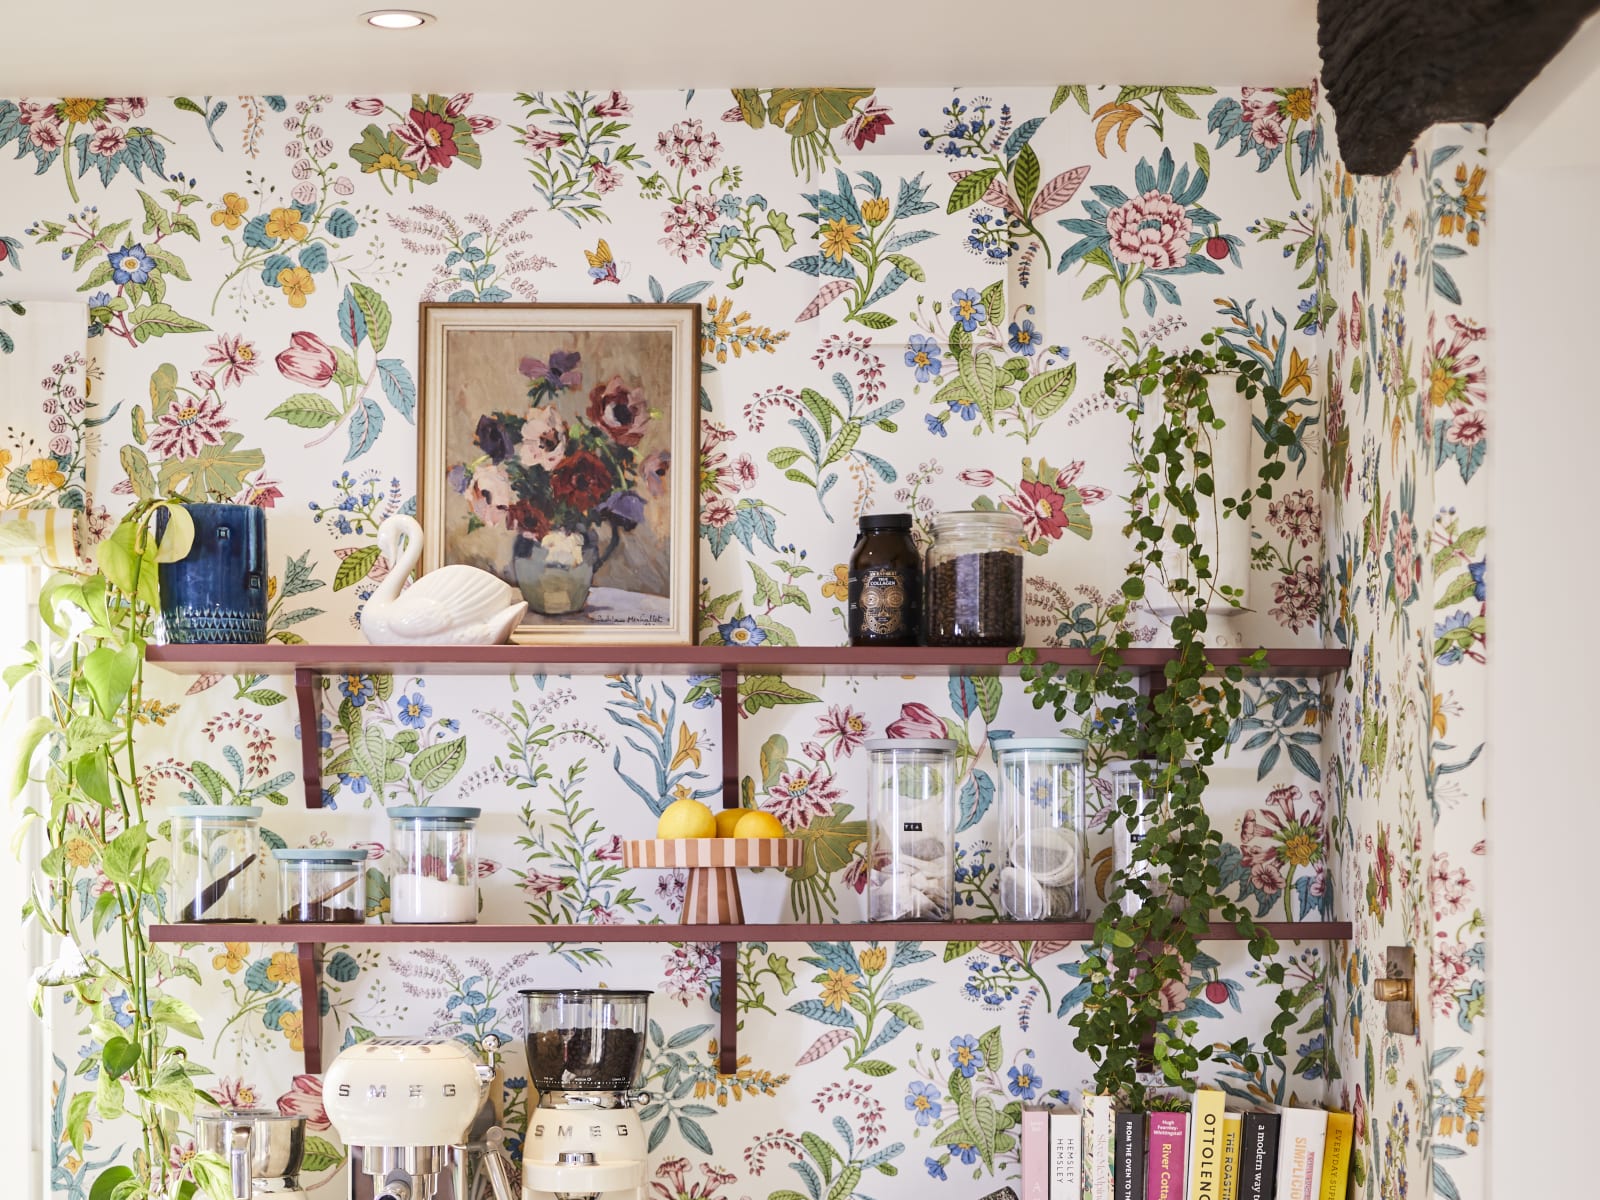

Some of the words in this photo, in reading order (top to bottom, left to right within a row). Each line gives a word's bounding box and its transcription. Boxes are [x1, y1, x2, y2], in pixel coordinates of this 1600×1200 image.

[338, 1084, 456, 1098] SMEG
[535, 1124, 628, 1137] SMEG
[1226, 1132, 1235, 1153] THE
[1256, 1132, 1266, 1171] modern
[1330, 1129, 1342, 1176] EVERYDAY
[1056, 1138, 1064, 1184] HEMSLEY
[1066, 1138, 1074, 1184] HEMSLEY
[1162, 1144, 1172, 1170] River
[1124, 1180, 1132, 1190] TO
[1251, 1172, 1262, 1193] way
